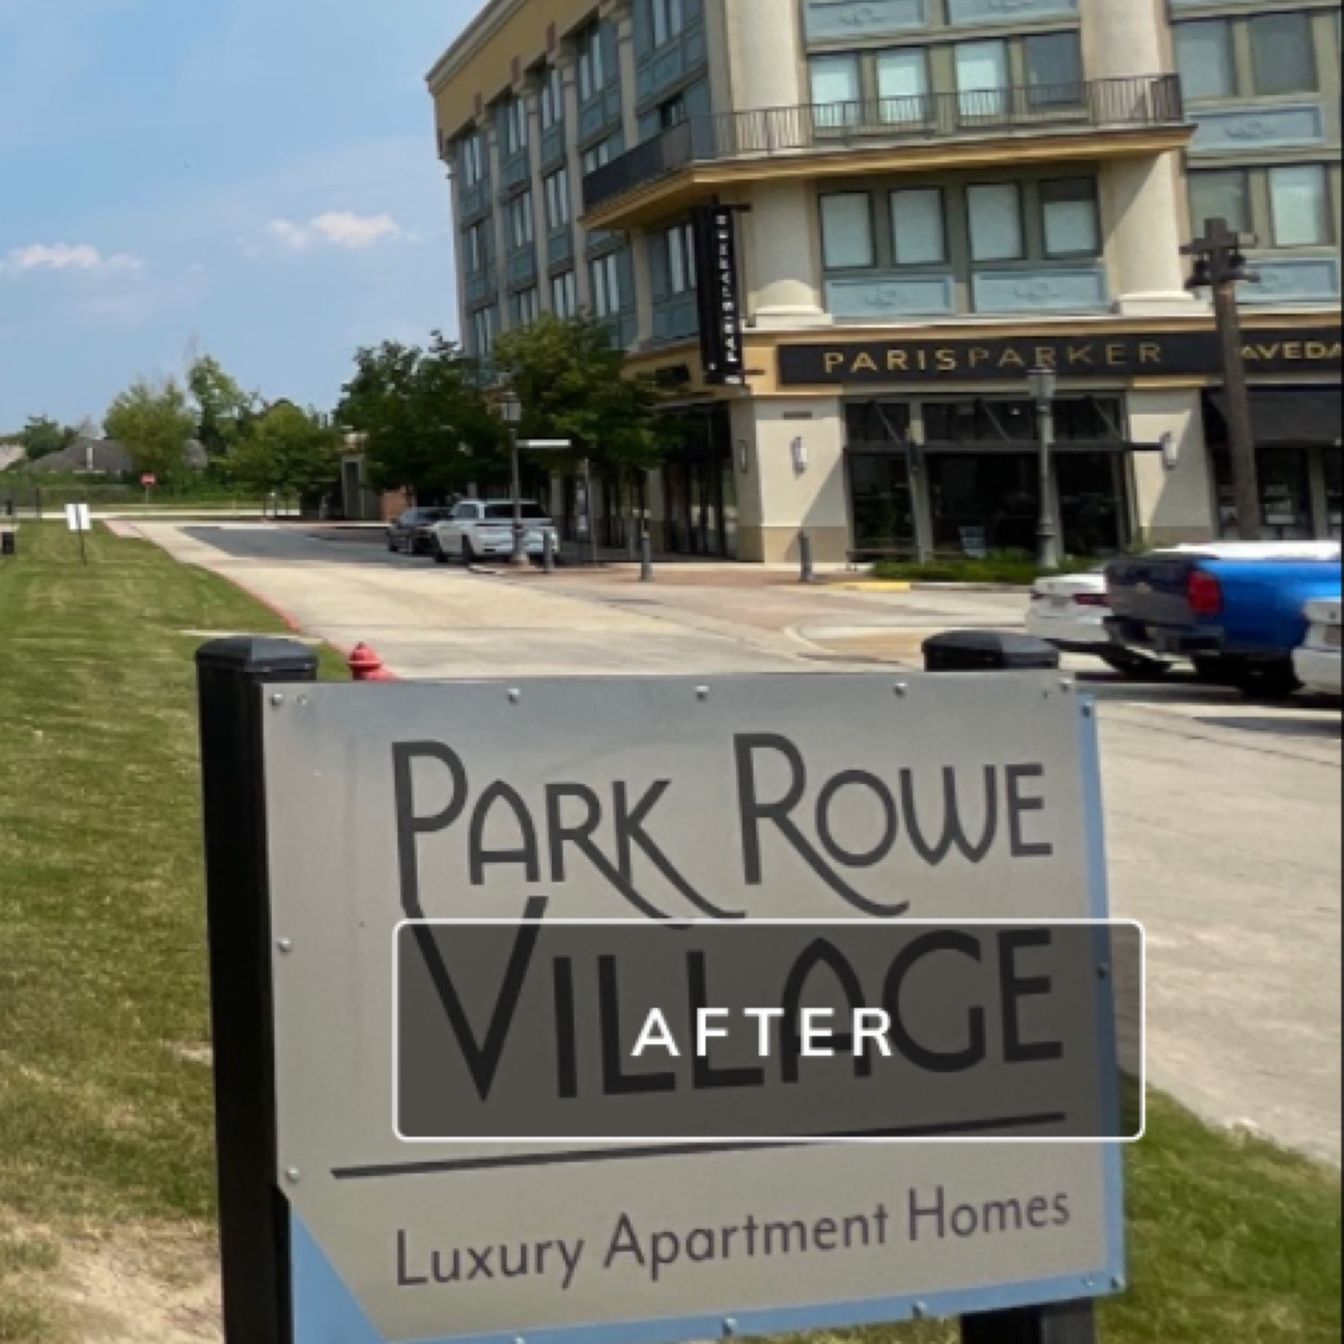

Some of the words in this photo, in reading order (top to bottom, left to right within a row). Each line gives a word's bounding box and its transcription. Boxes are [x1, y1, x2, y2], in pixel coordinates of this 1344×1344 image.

[392, 739, 746, 930] PARK
[732, 732, 1054, 917] ROWE
[397, 895, 1064, 1103] VILLAGE
[397, 1228, 584, 1290] Luxury
[604, 1203, 889, 1282] Apartment
[908, 1185, 1071, 1242] Homes
